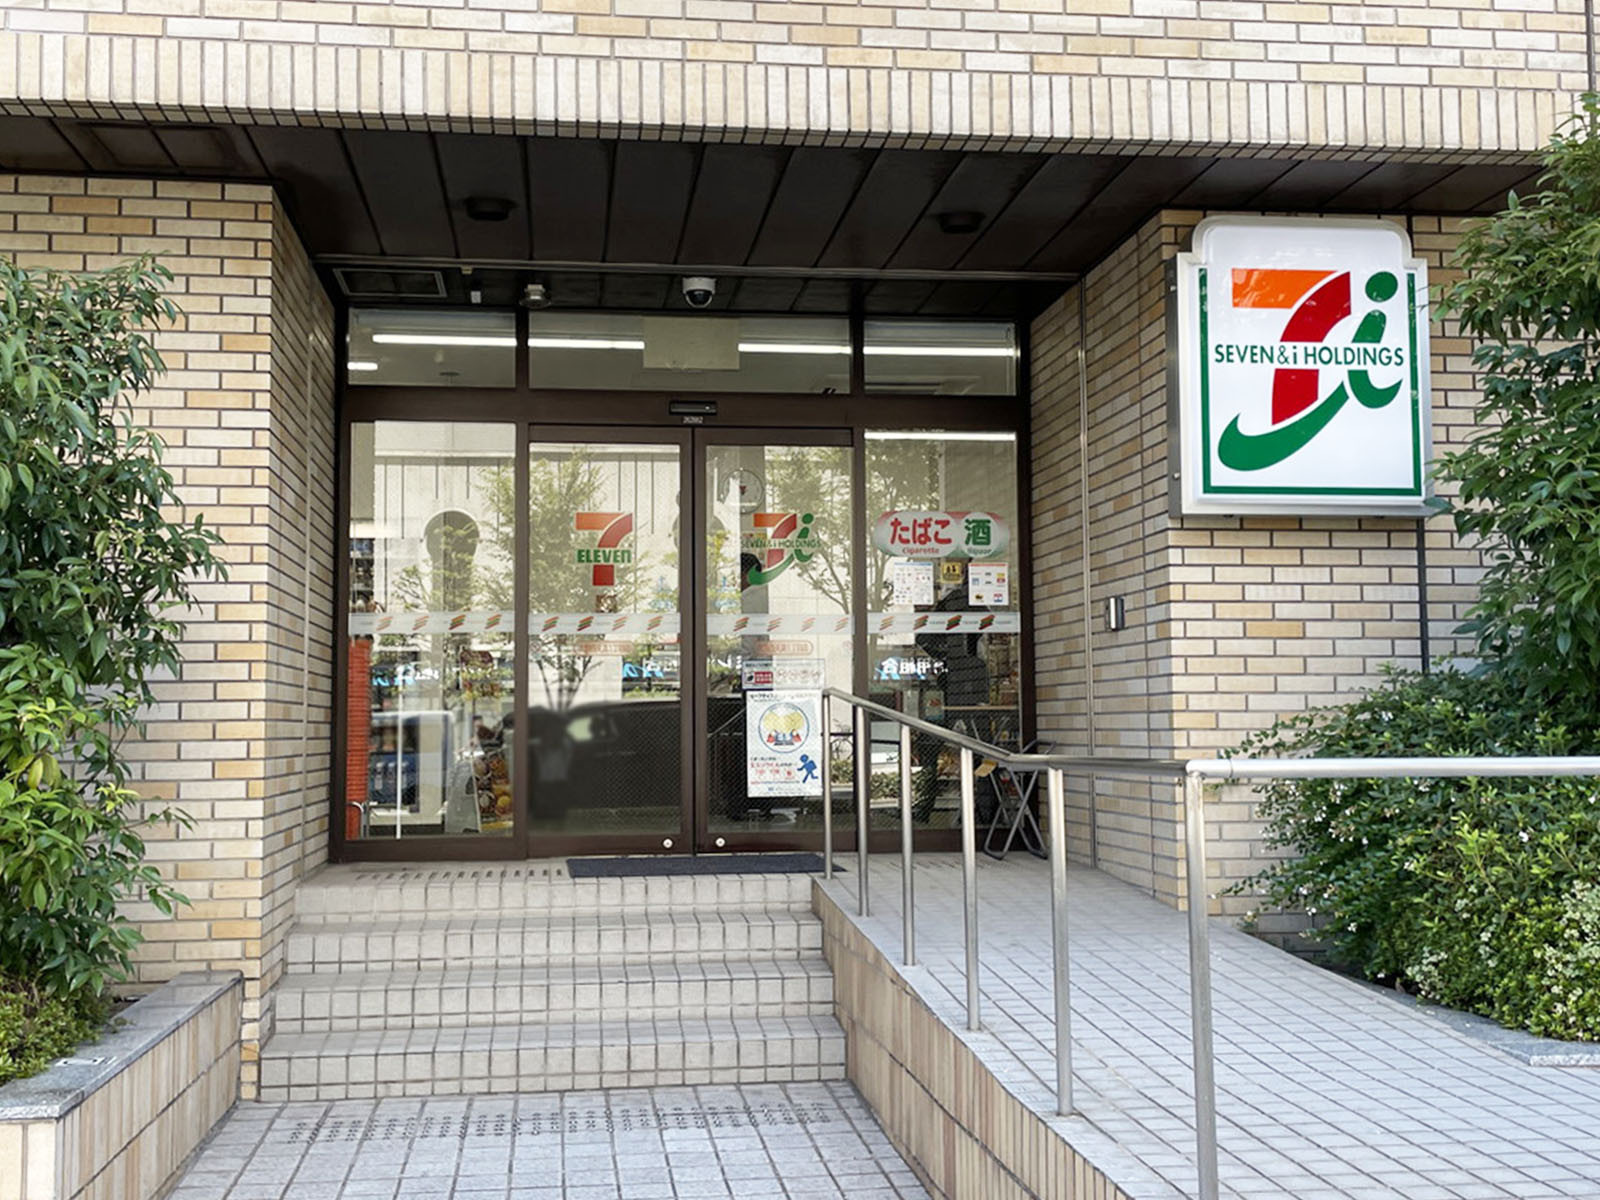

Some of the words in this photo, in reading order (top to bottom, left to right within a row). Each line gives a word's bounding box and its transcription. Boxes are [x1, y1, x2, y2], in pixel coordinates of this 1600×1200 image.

[1304, 346, 1404, 367] HOLDINGS
[890, 518, 952, 545] たばこ
[964, 519, 991, 546] 酒
